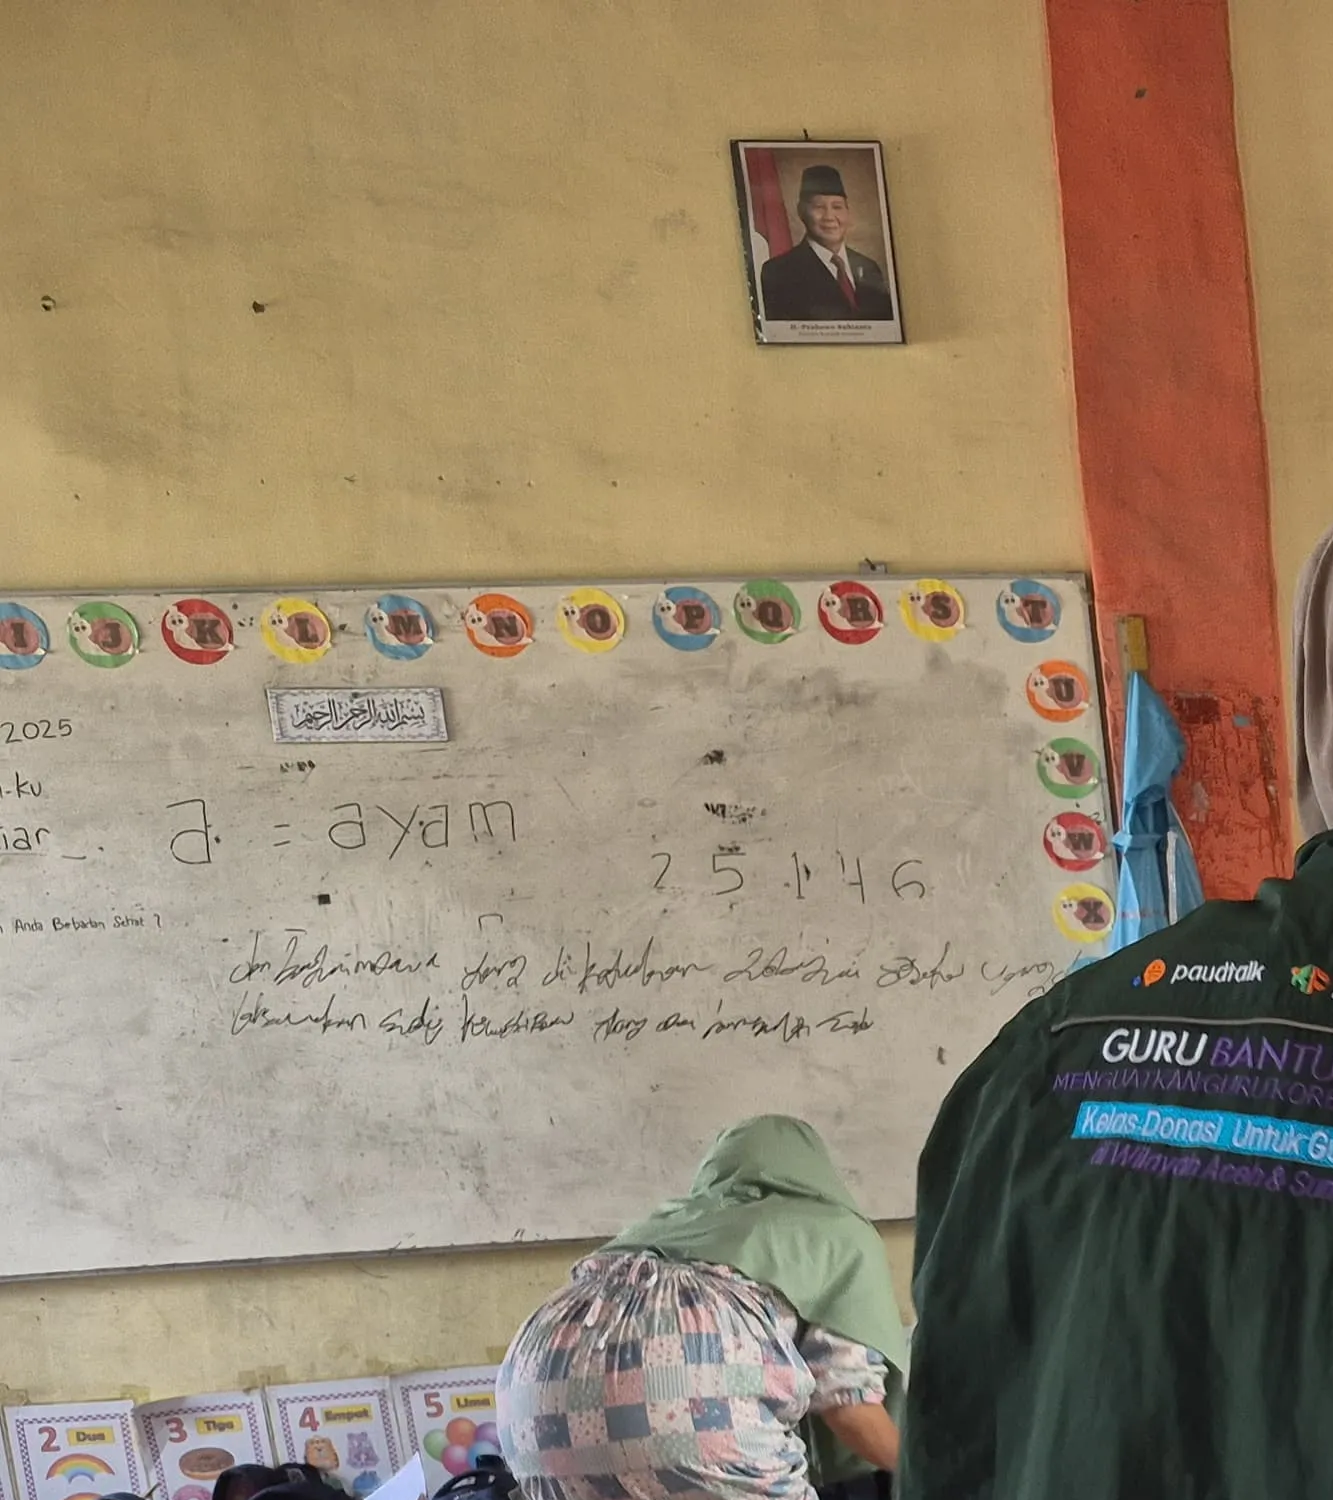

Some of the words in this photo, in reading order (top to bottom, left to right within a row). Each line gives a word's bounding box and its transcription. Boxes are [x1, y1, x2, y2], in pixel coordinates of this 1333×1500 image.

[684, 605, 706, 629] P
[850, 598, 873, 622] R
[929, 593, 952, 620] S
[1026, 602, 1051, 626] T
[101, 622, 121, 648] J
[193, 619, 222, 646] K
[299, 619, 322, 646] L
[393, 614, 422, 637] M
[492, 615, 519, 637] N
[1051, 677, 1075, 701] U
[1, 718, 73, 744] 2025
[1064, 753, 1088, 777] V
[328, 800, 517, 861] ayam
[1064, 831, 1094, 852] W
[1081, 903, 1107, 925] X
[1170, 960, 1266, 984] paudtalk
[1102, 1027, 1208, 1067] GURU
[1082, 1105, 1137, 1134] Kelas
[1141, 1109, 1224, 1144] Donasi
[1232, 1119, 1301, 1155] Untuk
[423, 1392, 444, 1418] 5
[166, 1418, 188, 1443] 3
[299, 1406, 320, 1432] 4
[38, 1426, 59, 1453] 2
